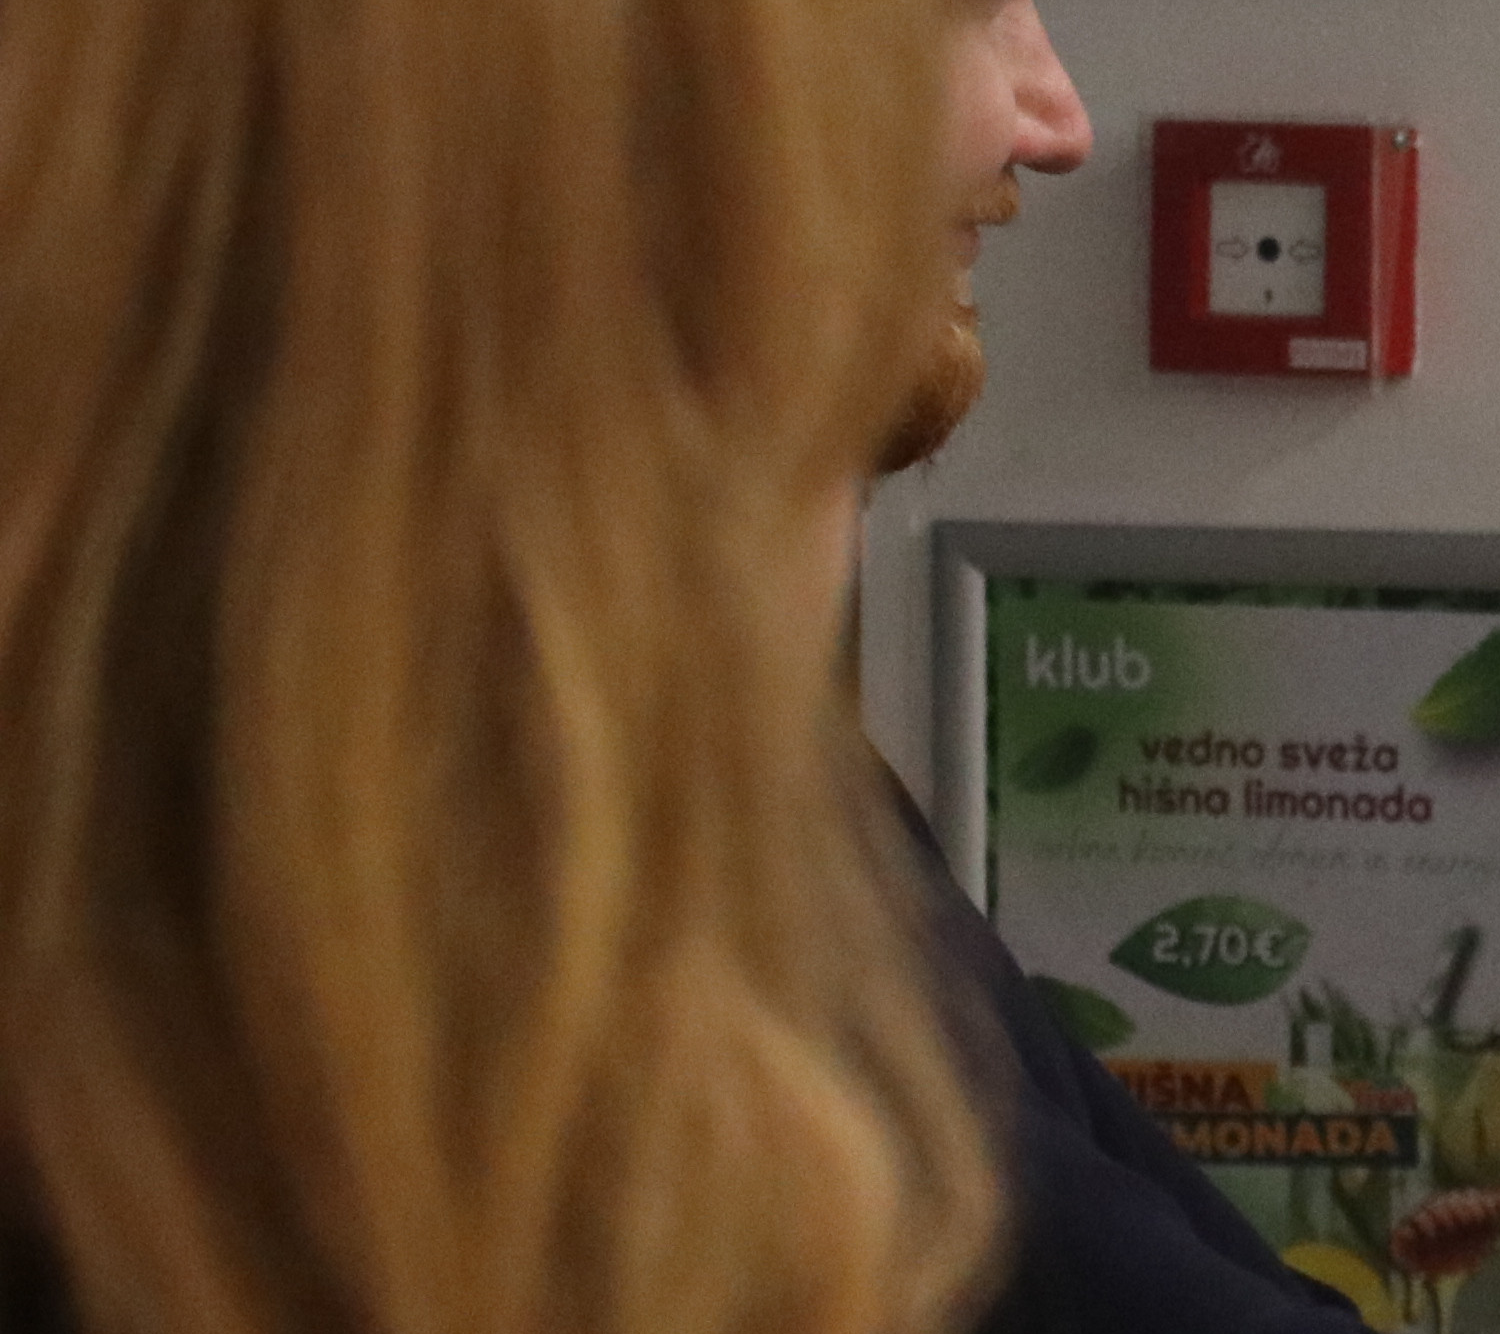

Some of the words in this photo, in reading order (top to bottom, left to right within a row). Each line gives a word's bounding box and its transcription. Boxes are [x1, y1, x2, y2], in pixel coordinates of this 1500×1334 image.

[1025, 633, 1153, 690] klub
[1138, 731, 1265, 769] vedno
[1277, 732, 1399, 773] sveža
[1117, 775, 1231, 818] hišna
[1242, 778, 1433, 824] limonada
[1172, 1119, 1397, 1155] MONADA
